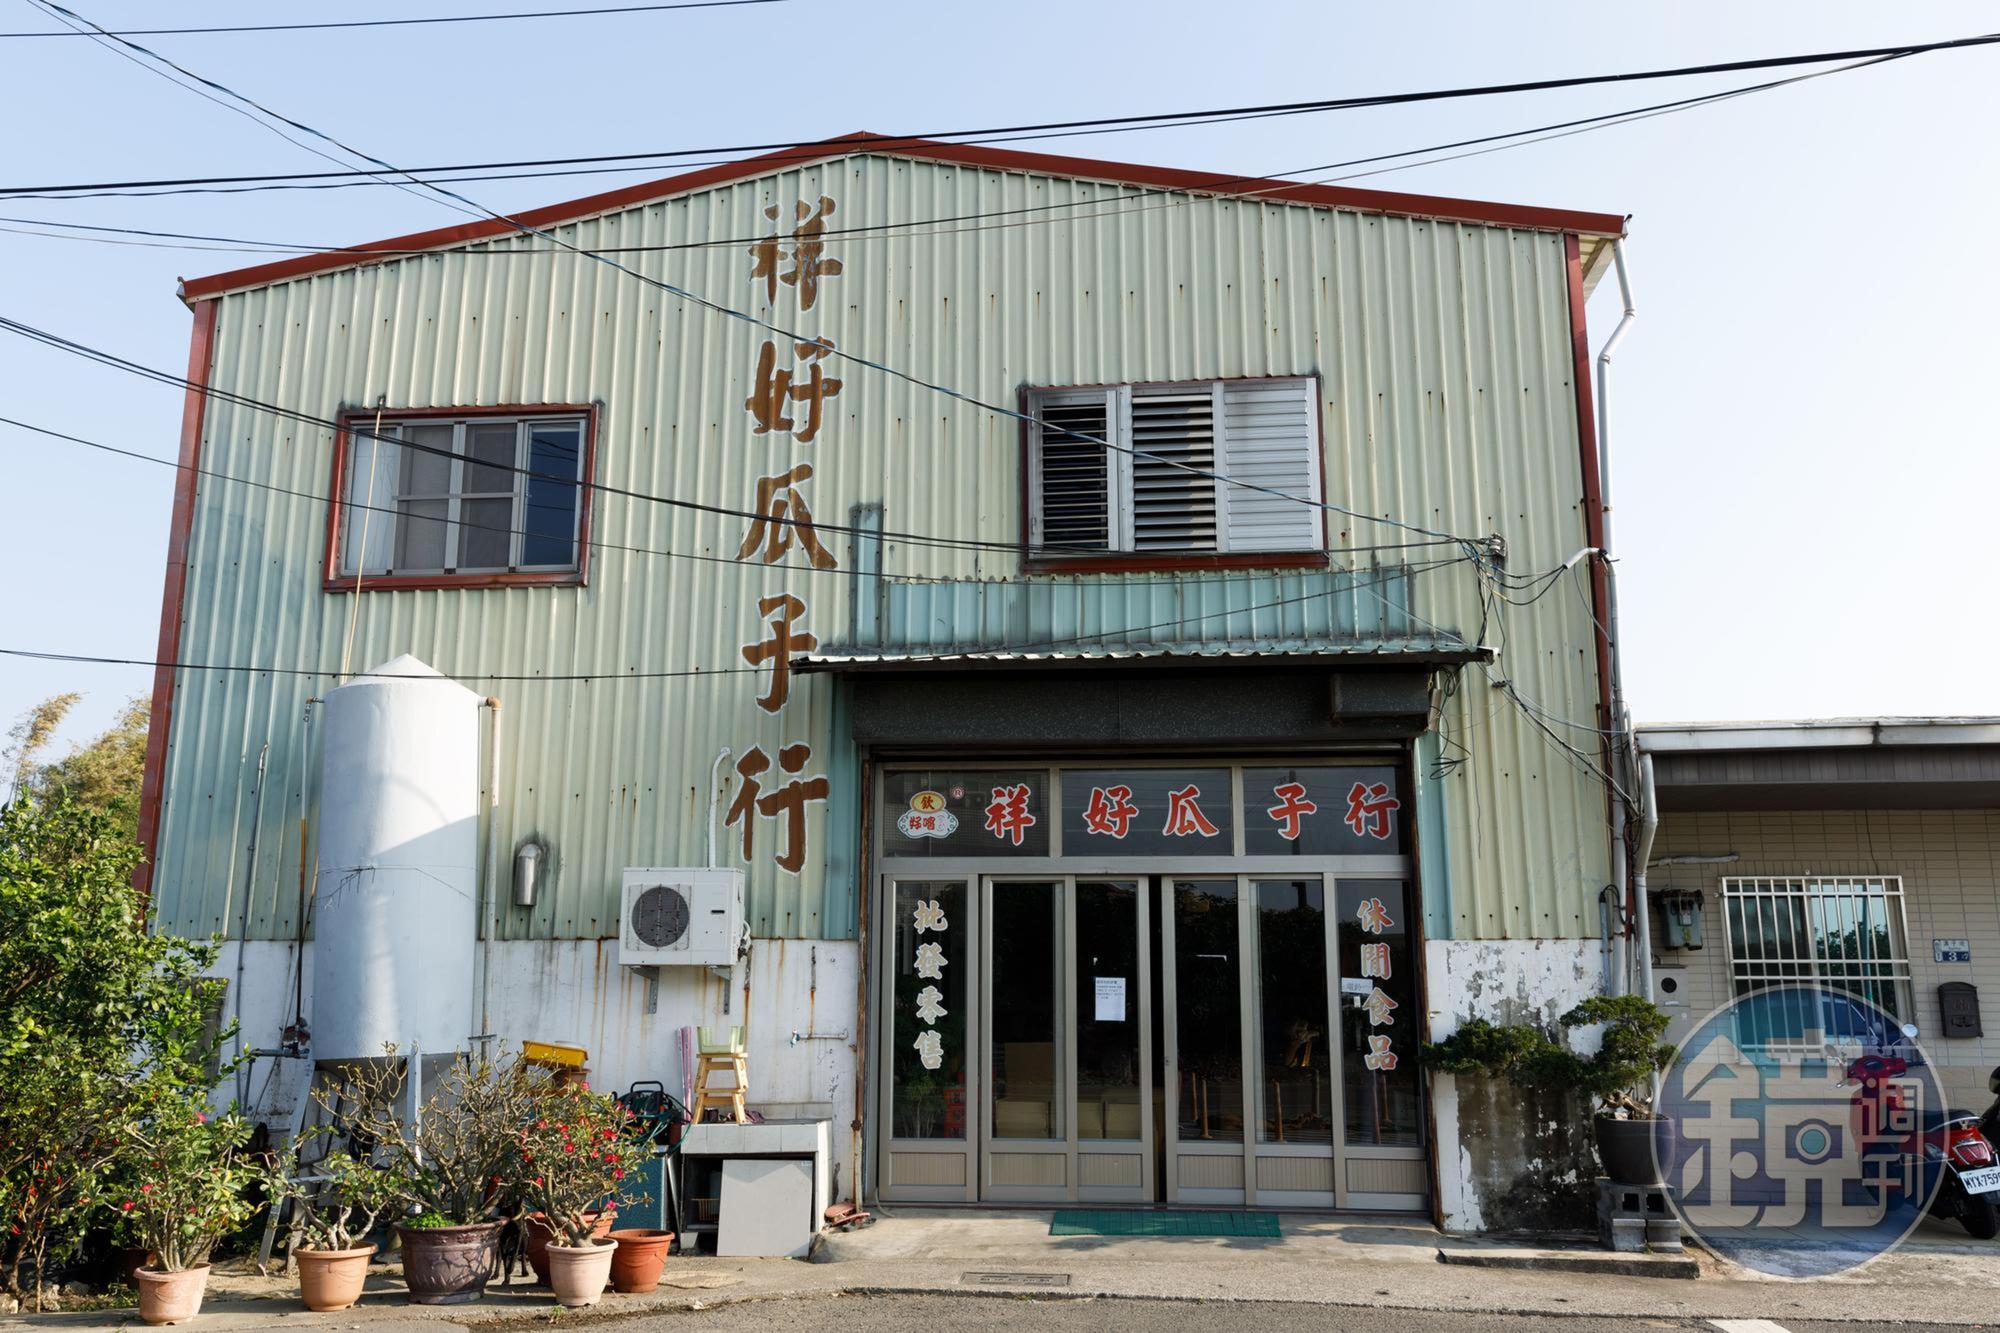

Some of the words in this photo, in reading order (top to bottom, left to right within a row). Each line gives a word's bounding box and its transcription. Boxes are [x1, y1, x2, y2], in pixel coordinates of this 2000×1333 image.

[726, 195, 843, 875] 祥好瓜子行
[984, 782, 1400, 846] 祥好瓜子行
[914, 900, 948, 1070] 批發零售
